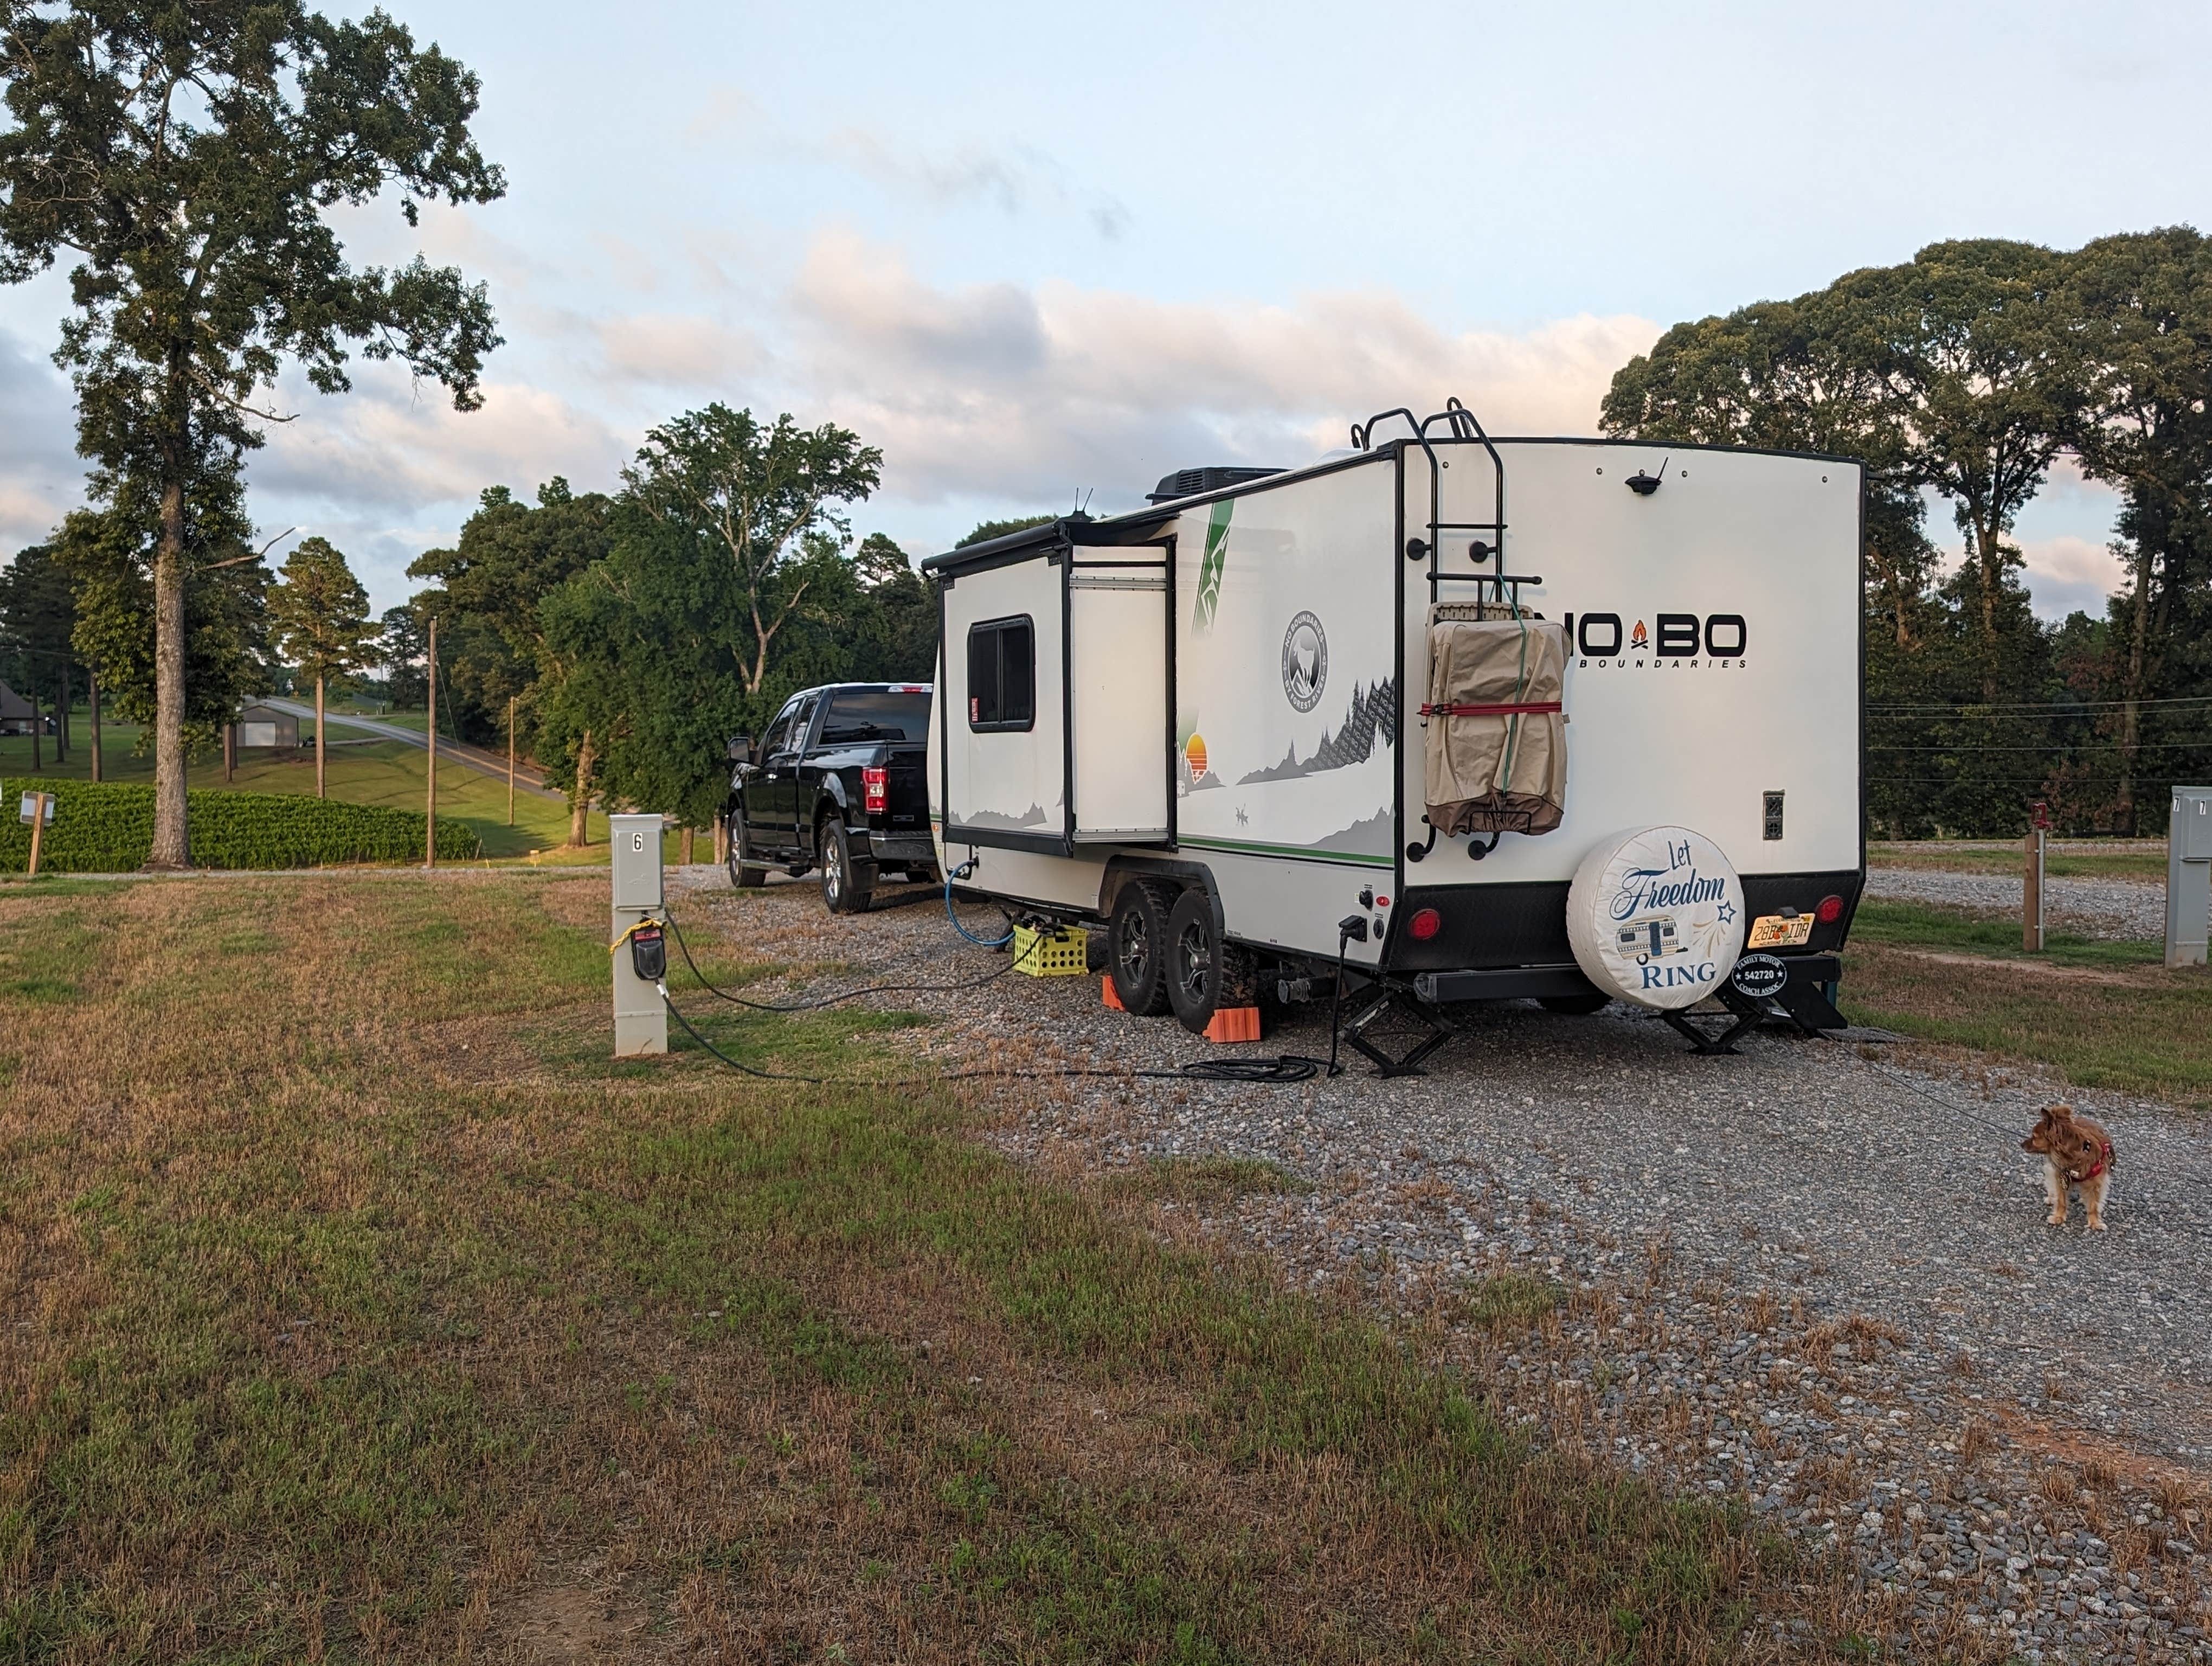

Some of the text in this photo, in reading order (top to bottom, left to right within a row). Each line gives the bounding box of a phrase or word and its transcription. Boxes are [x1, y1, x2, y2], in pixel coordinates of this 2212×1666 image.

[1285, 614, 1324, 648] NO BOUNDARIES
[1579, 659, 1746, 668] BOUNDARIES
[1285, 674, 1324, 709] BY FOREST RIVER
[2175, 797, 2179, 811] 7
[2201, 800, 2205, 813] 7
[634, 834, 641, 850] 6
[1668, 839, 1692, 870] Let
[1609, 867, 1725, 920] Freedom
[1737, 956, 1780, 970] FAMILY MOTOR
[1641, 962, 1716, 989] RING
[1744, 970, 1774, 981] 542720
[1739, 981, 1782, 995] COACH ASSOC.
